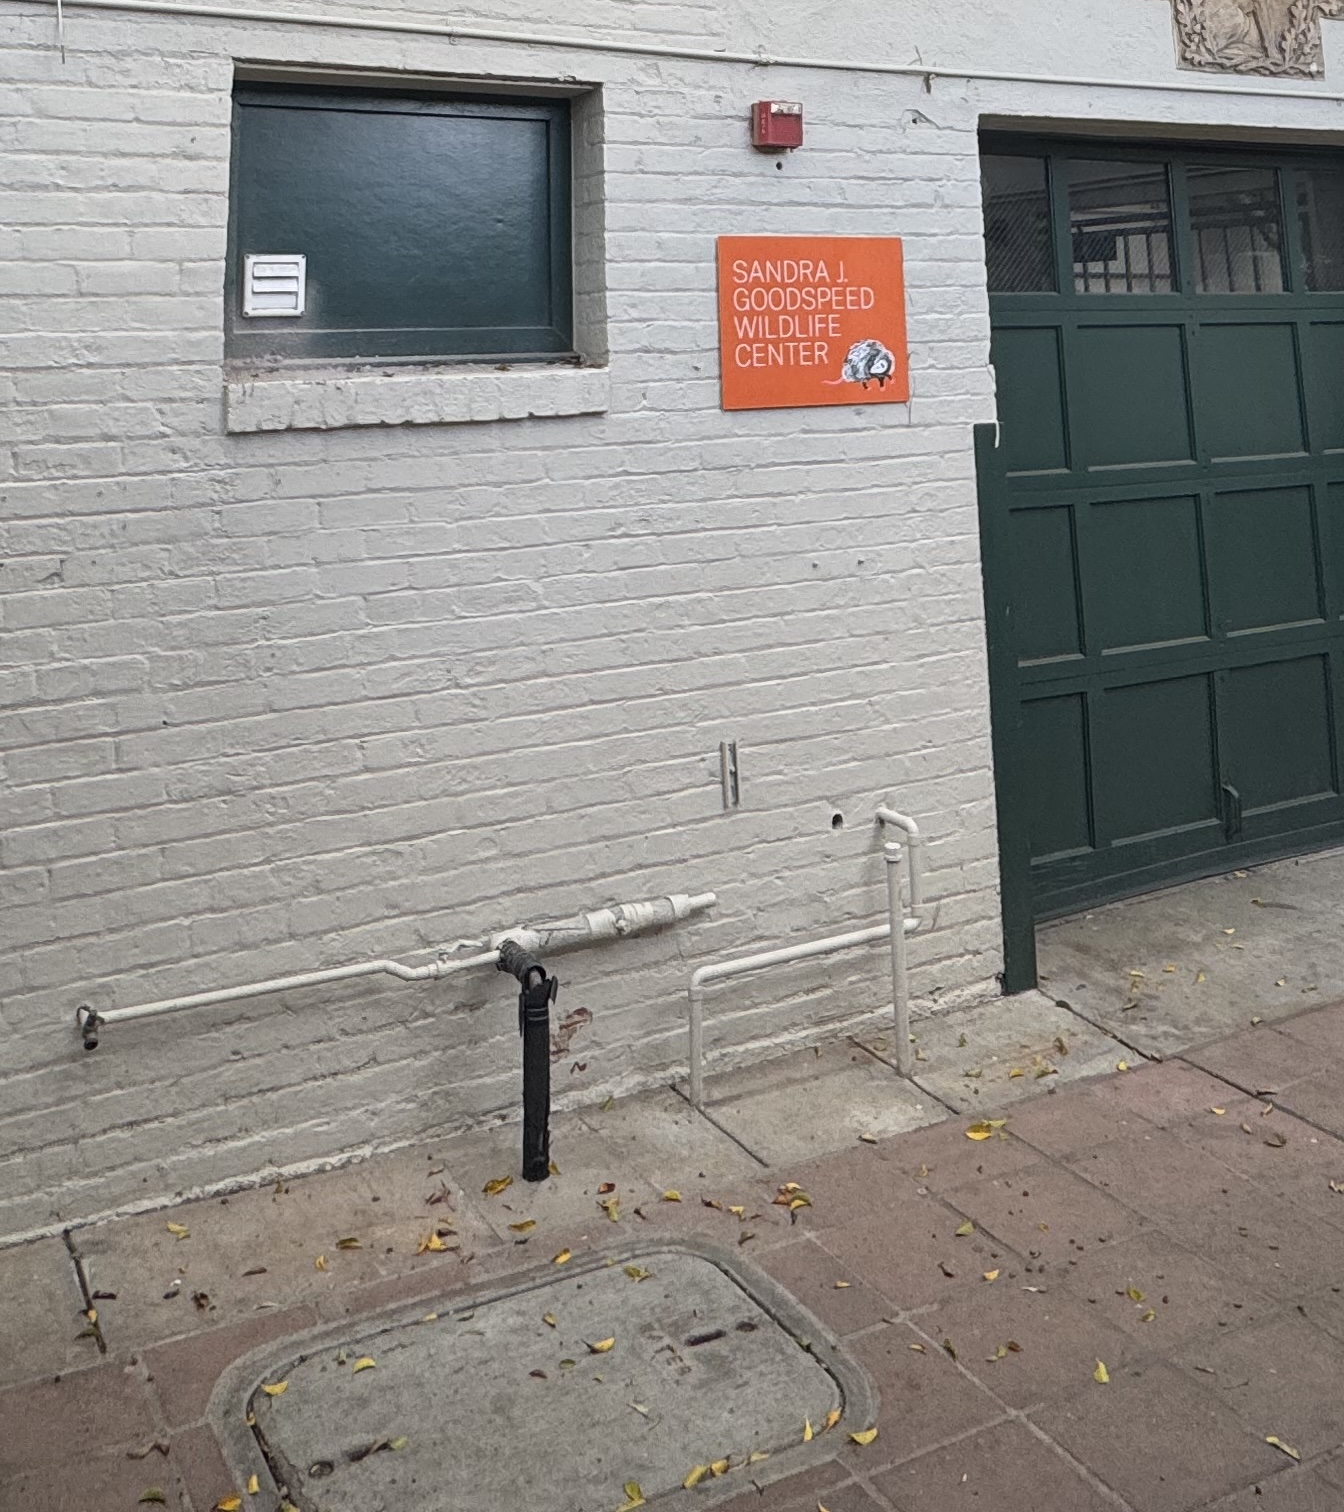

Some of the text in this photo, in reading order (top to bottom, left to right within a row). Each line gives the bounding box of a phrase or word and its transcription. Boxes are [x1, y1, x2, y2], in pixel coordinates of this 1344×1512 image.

[732, 259, 848, 284] SANDRA J.
[732, 287, 875, 311] GOODSPEED
[733, 314, 842, 339] WILDLIFE
[735, 342, 829, 368] CENTER
